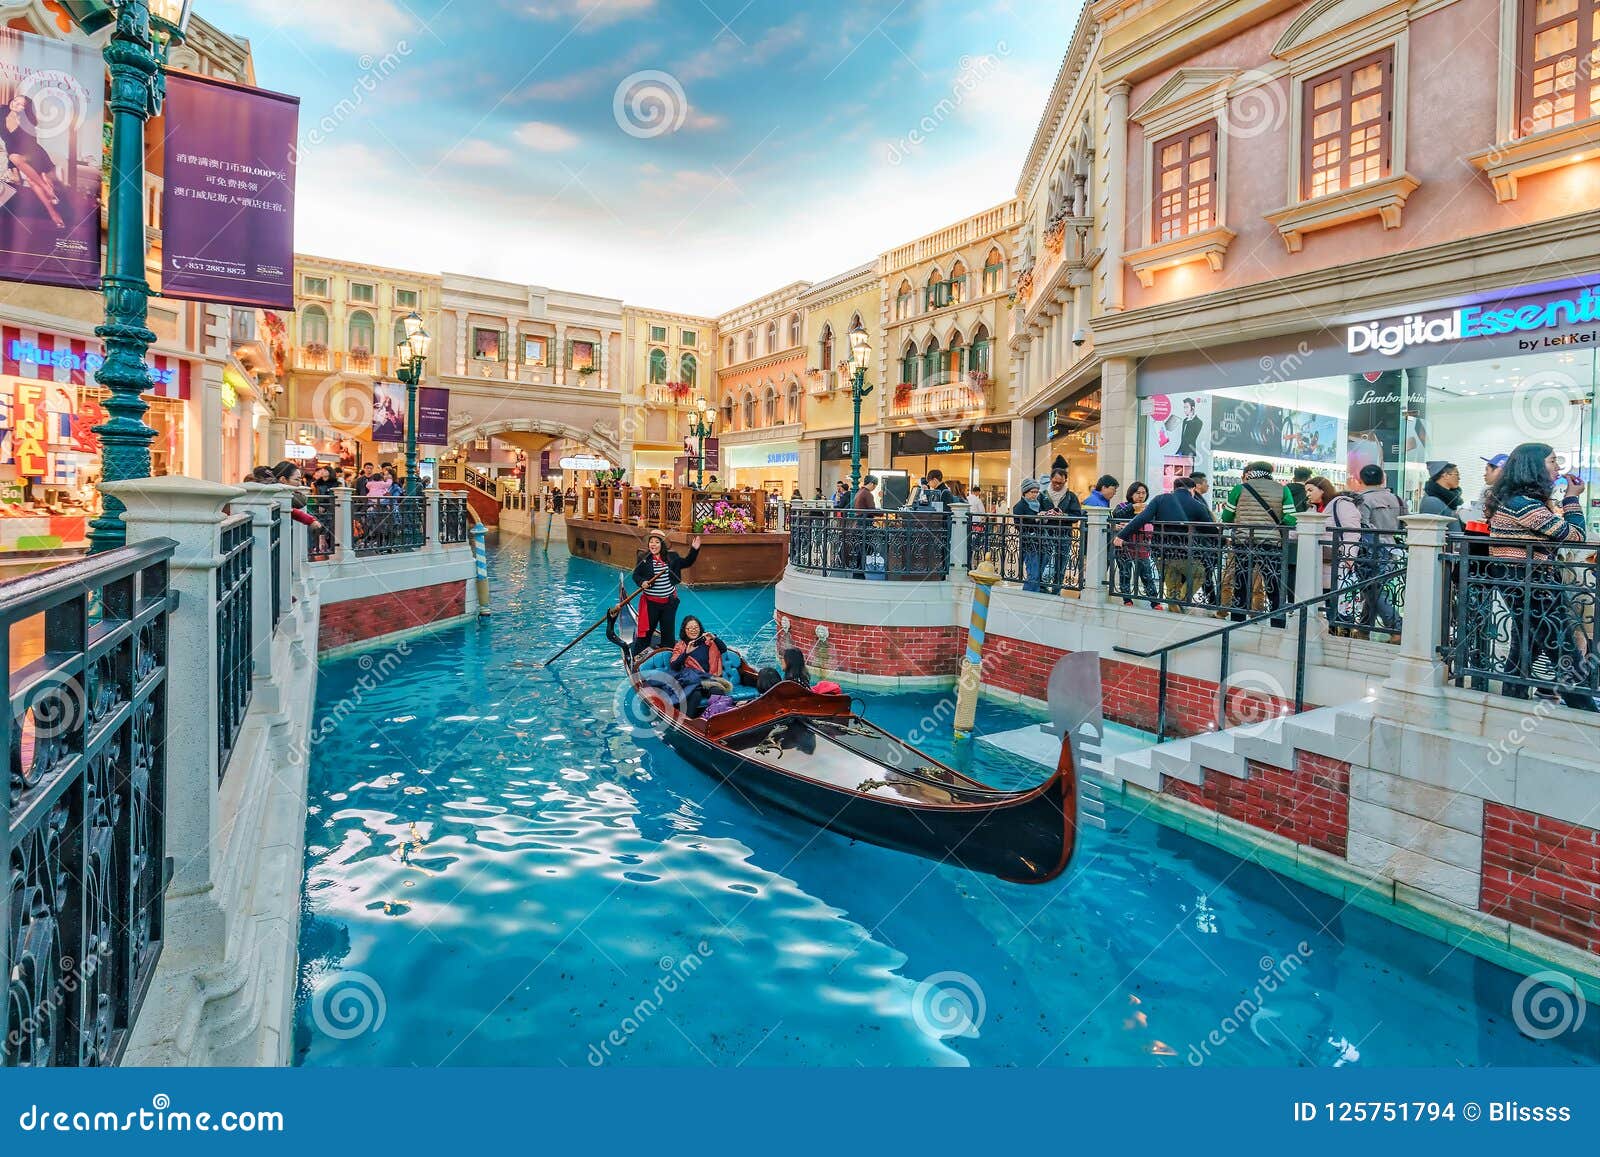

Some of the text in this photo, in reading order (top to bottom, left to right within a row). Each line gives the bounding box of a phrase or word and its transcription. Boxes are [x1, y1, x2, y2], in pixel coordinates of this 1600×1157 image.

[9, 339, 80, 370] Hush
[1519, 339, 1539, 352] by
[16, 385, 46, 475] FINAL
[937, 429, 961, 444] DG
